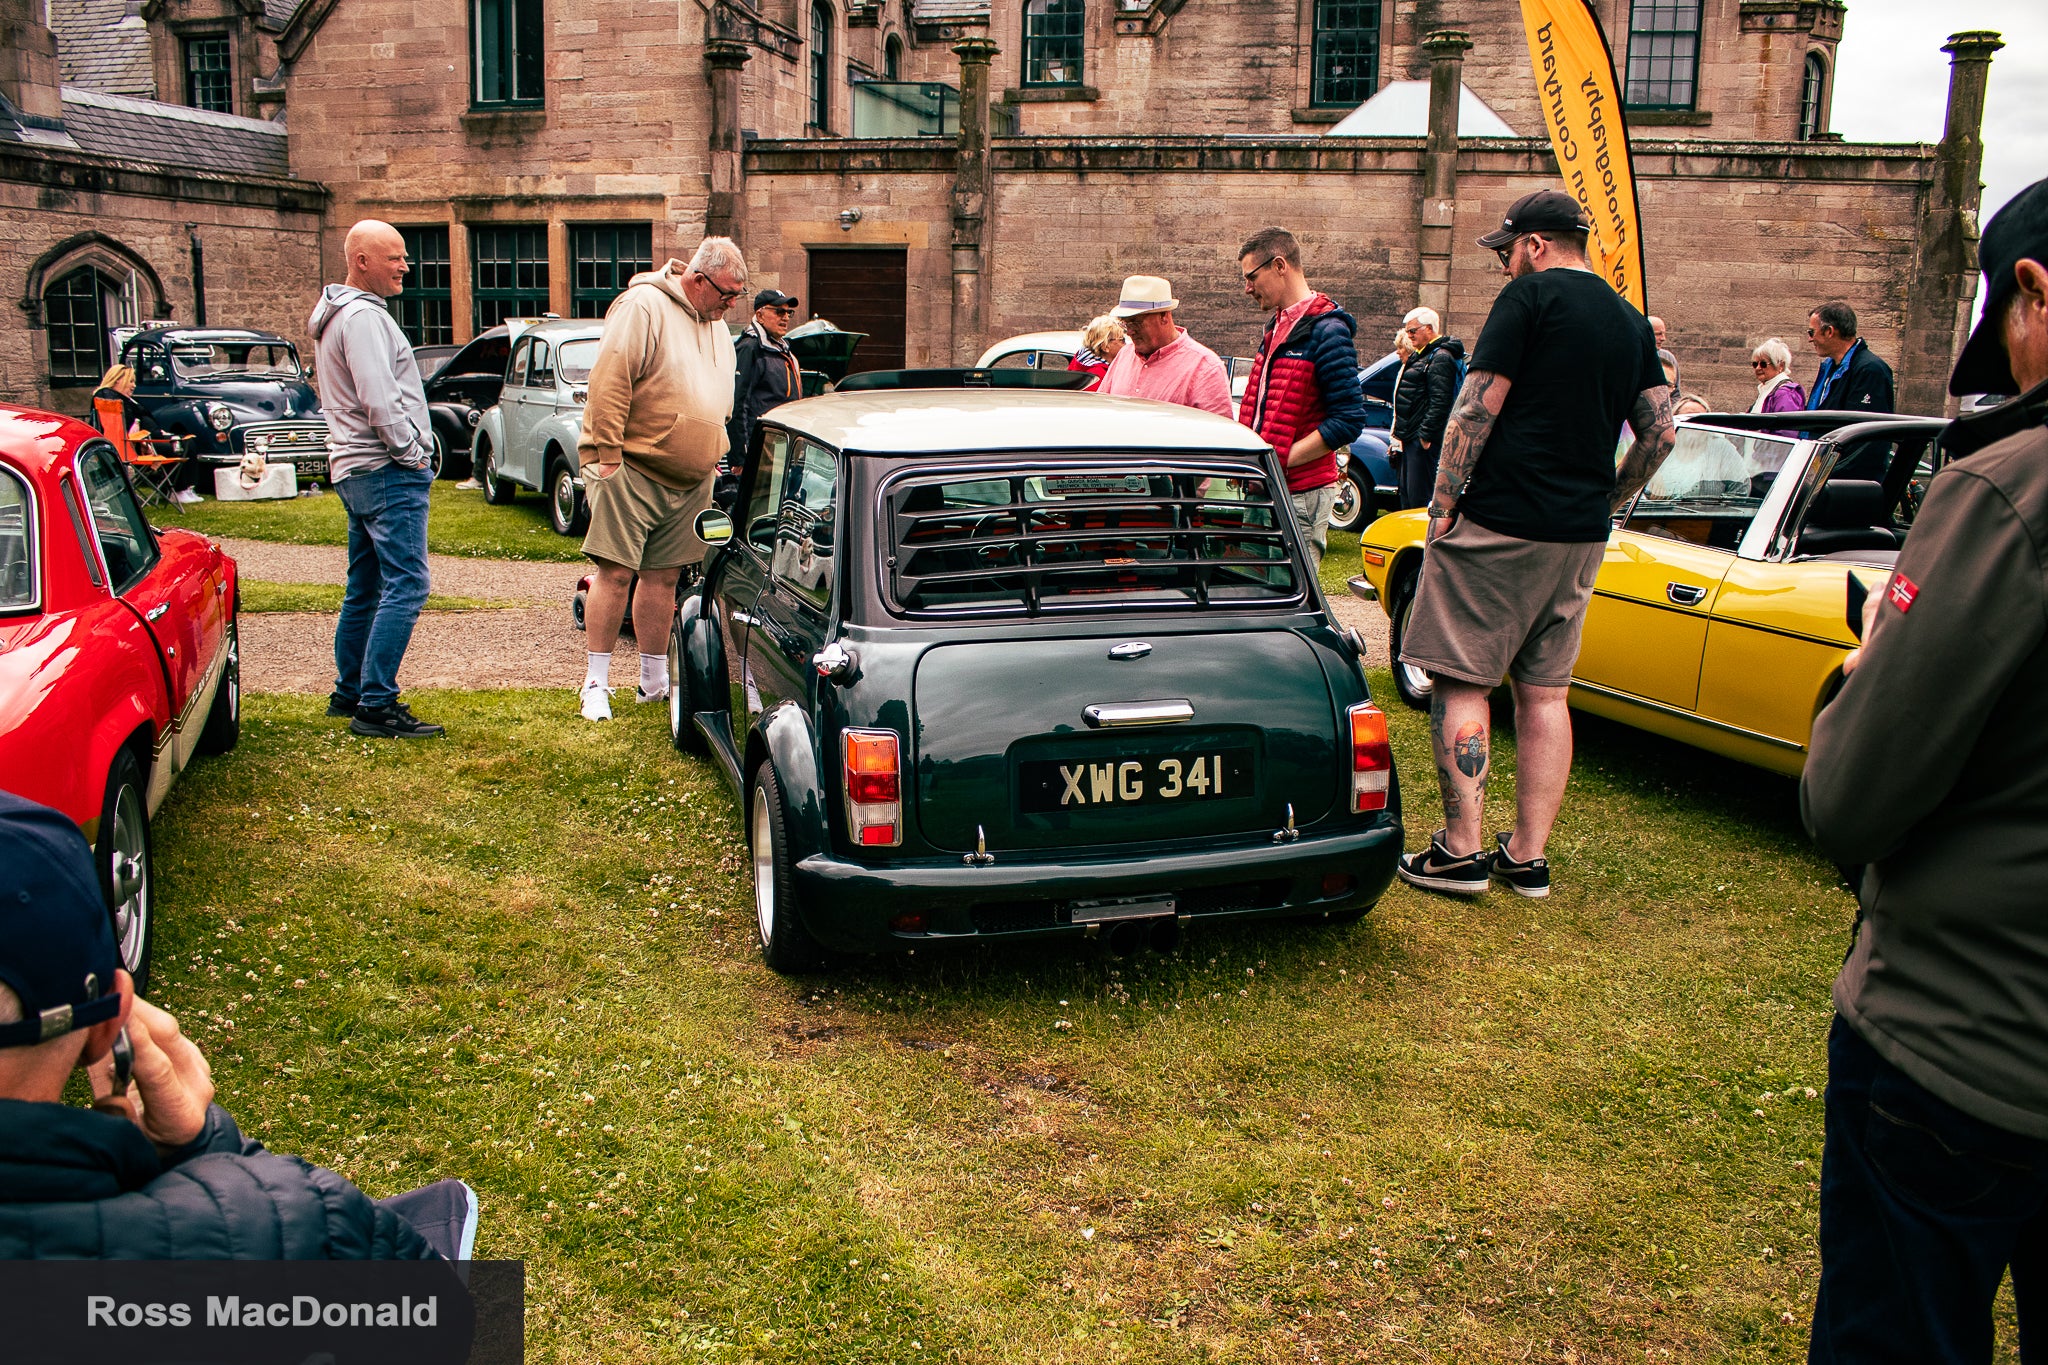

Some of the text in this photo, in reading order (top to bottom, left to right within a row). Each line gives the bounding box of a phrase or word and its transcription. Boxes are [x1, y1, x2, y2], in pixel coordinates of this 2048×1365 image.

[297, 461, 329, 472] 329H
[1059, 755, 1222, 805] XWG 341
